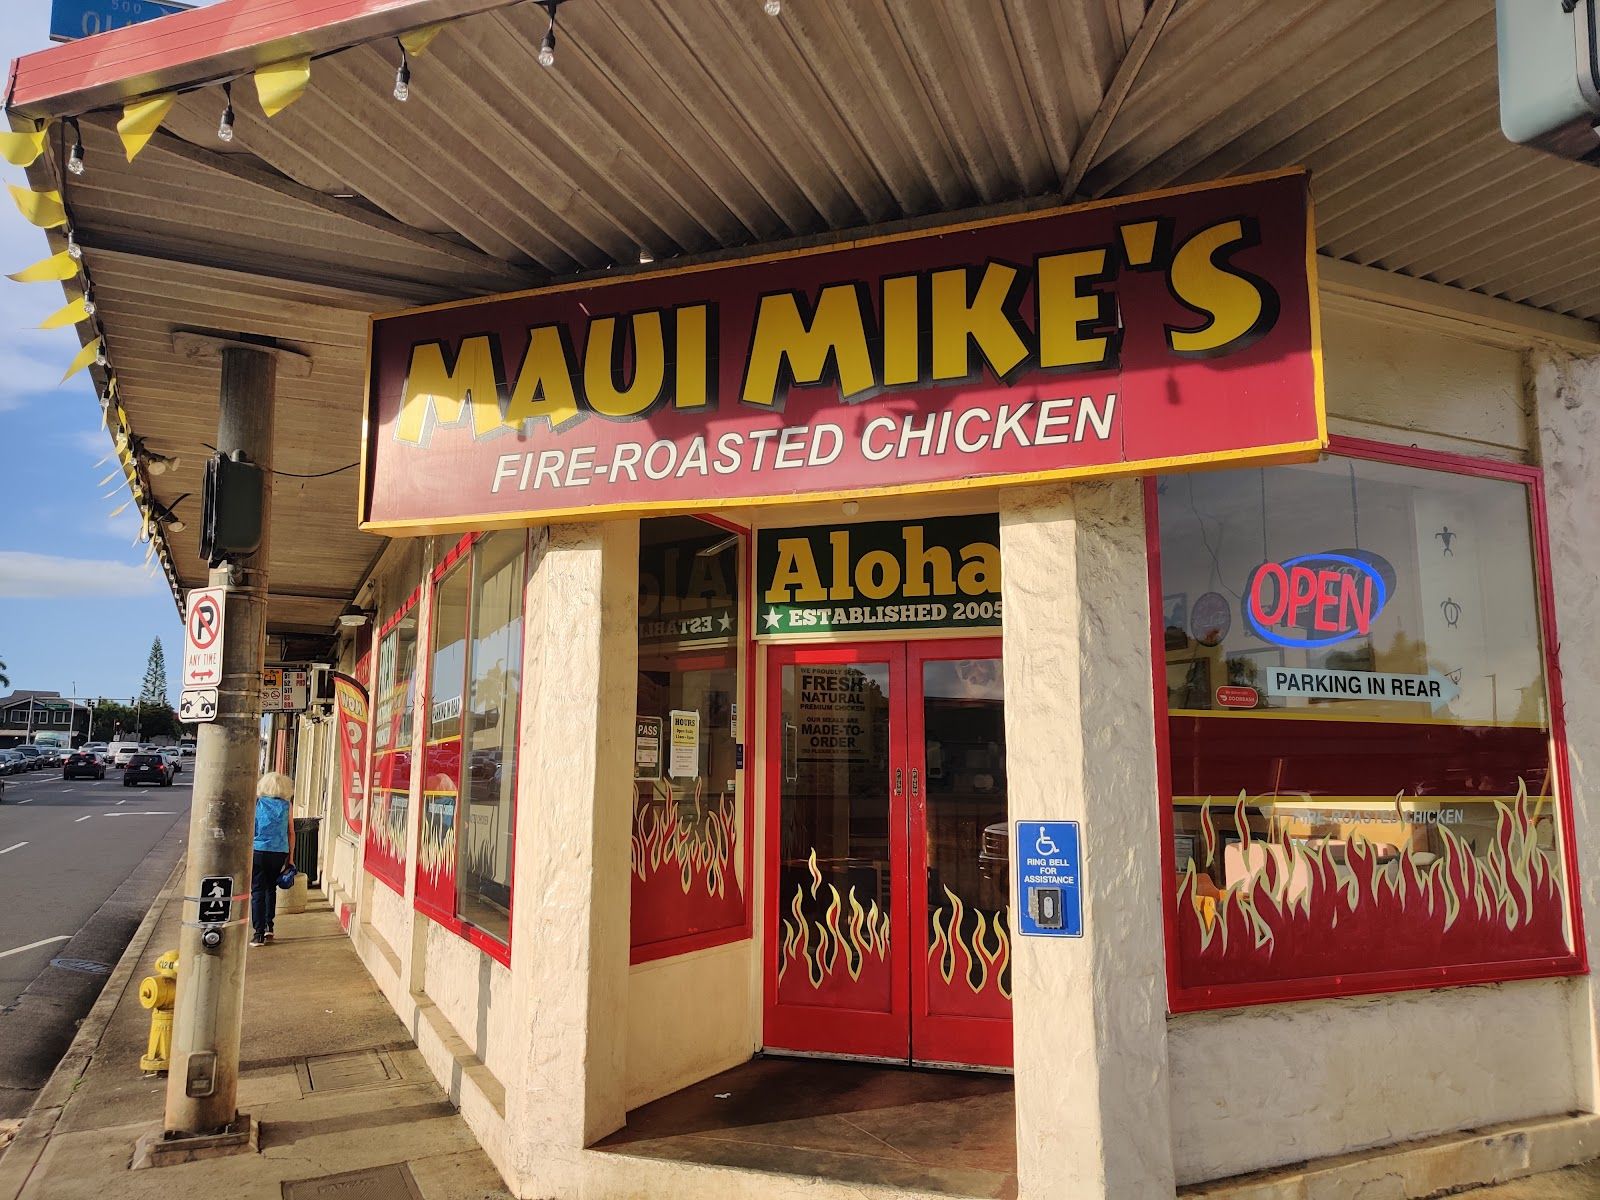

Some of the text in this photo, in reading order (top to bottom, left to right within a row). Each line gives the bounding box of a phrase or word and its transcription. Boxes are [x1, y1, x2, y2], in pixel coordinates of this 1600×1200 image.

[393, 218, 1275, 446] MAUI MIKE'S
[491, 393, 1117, 494] FIRE-ROASTED CHICKEN
[765, 526, 1001, 603] Aloha
[1251, 562, 1372, 634] OPEN
[789, 601, 1002, 627] ESTABLISHED 2005
[189, 652, 217, 666] ANY TIME
[802, 676, 864, 692] FRESH
[1276, 672, 1441, 698] PARKING IN REAR
[801, 691, 865, 705] NATURAL
[638, 724, 658, 735] PASS
[801, 724, 865, 736] MADE-TO-
[810, 736, 857, 748] ORDER
[1404, 809, 1464, 824] CHICKEN
[1026, 858, 1070, 867] RING BELL
[1039, 867, 1057, 875] FOR
[1024, 875, 1074, 884] ASSISTANCE
